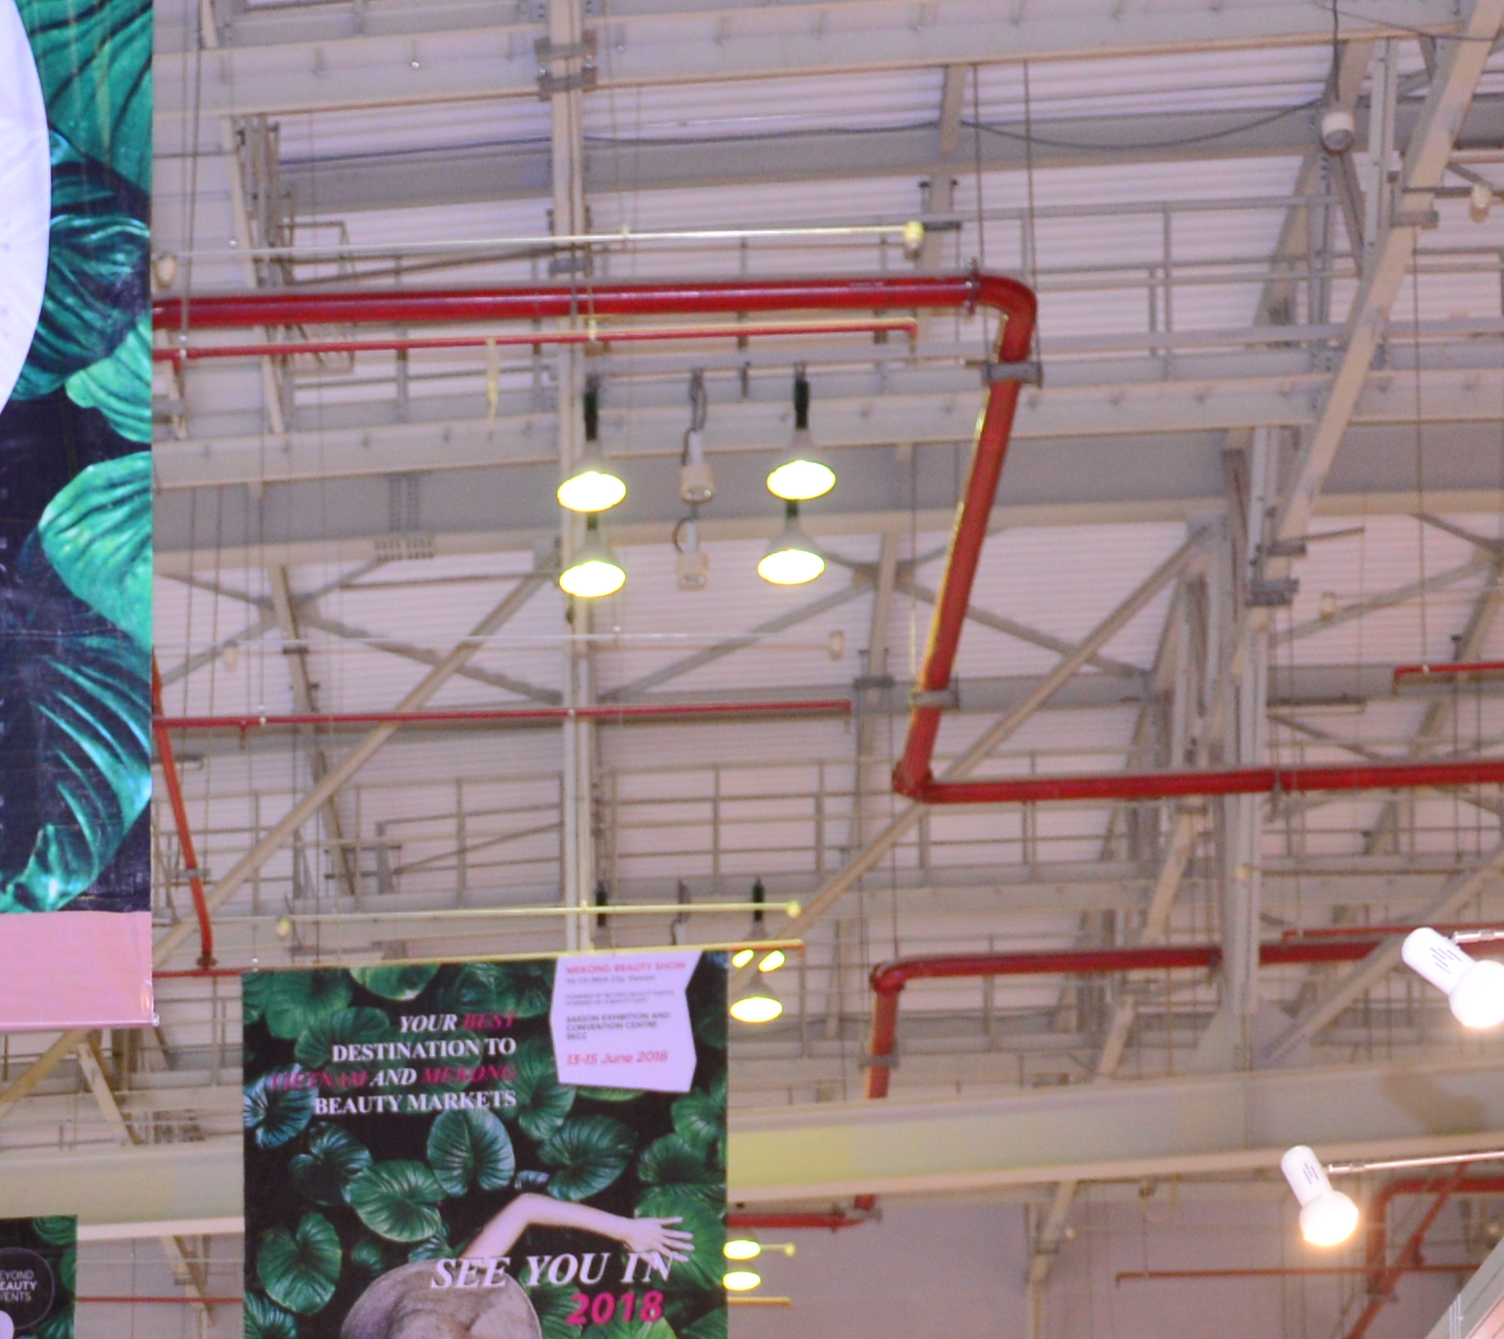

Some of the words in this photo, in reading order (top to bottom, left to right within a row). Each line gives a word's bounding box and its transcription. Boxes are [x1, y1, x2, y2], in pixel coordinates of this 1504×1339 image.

[399, 1014, 457, 1033] YOUR
[463, 1011, 516, 1031] BEST
[332, 1040, 480, 1062] DESTINATION
[484, 1038, 517, 1055] TO
[268, 1070, 368, 1092] VIETNAM
[369, 1068, 417, 1087] AND
[421, 1064, 517, 1084] MEKONG
[314, 1094, 403, 1115] BEAUTY
[407, 1090, 517, 1111] MARKETS
[431, 1258, 511, 1290] SEE
[527, 1253, 610, 1286] YOU
[620, 1251, 676, 1284] IN
[564, 1290, 665, 1326] 2018
